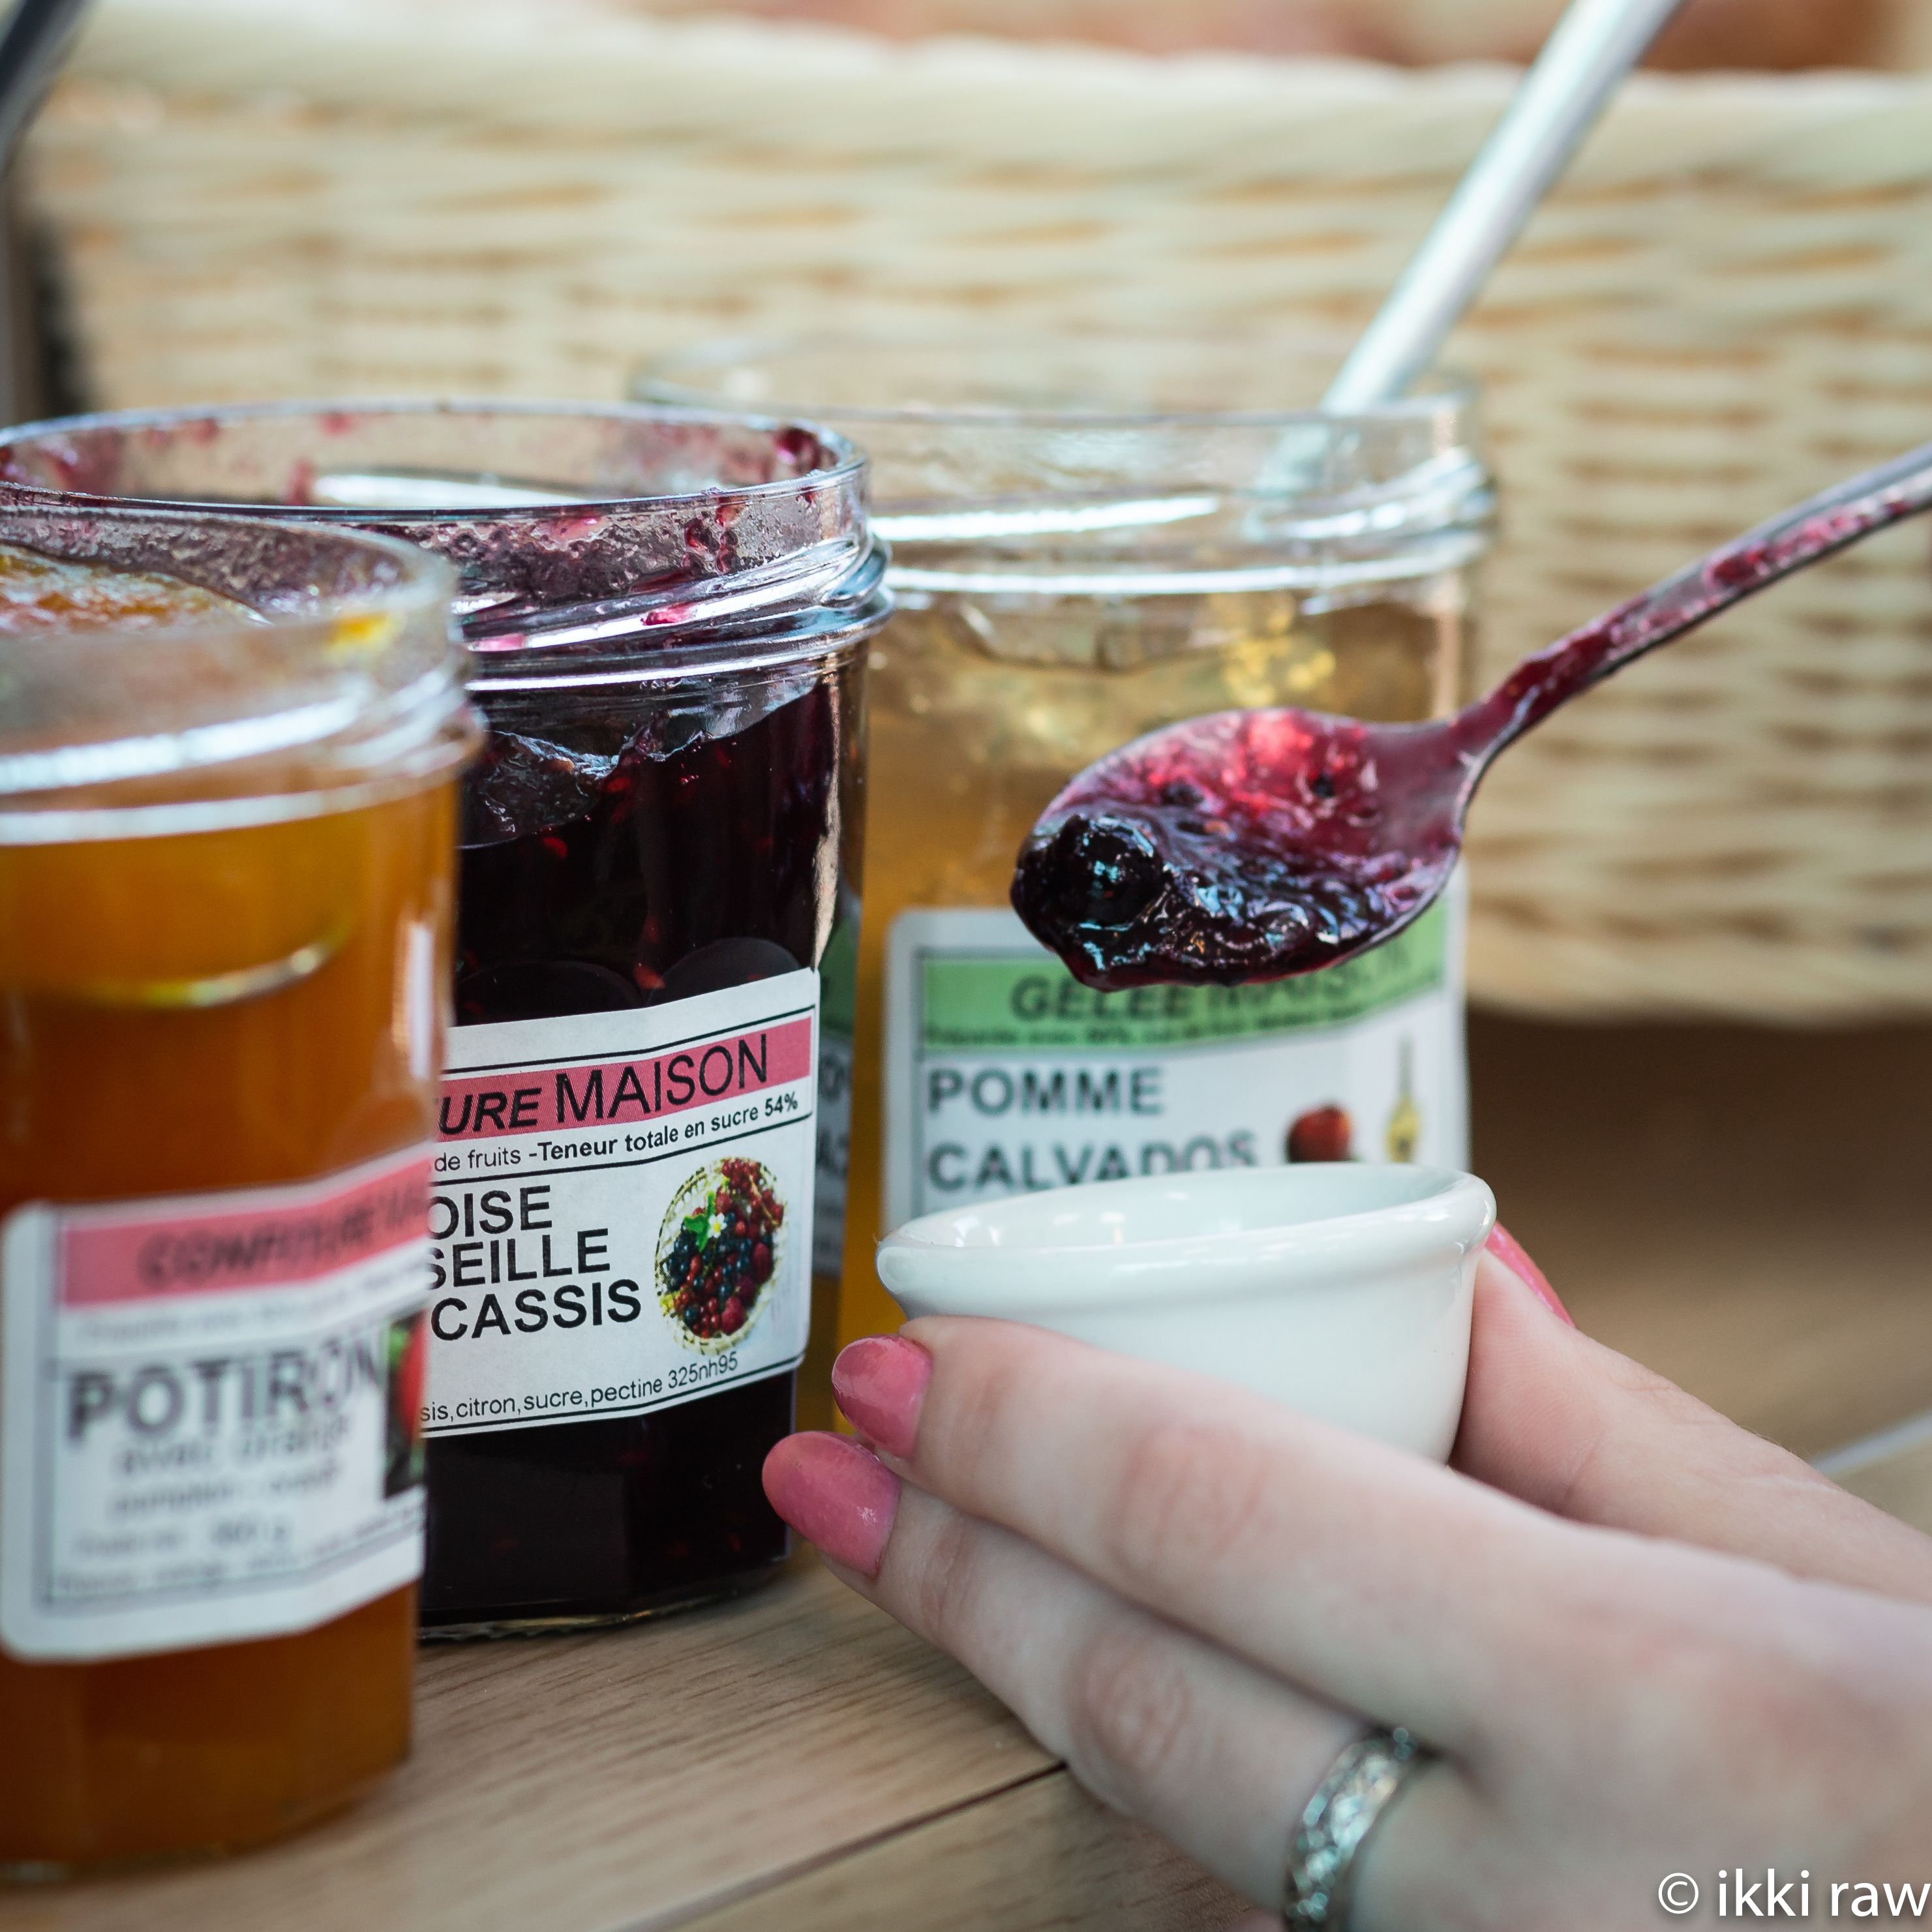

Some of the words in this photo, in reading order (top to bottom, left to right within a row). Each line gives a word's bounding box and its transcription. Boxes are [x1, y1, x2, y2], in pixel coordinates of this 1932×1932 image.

[555, 1034, 767, 1123] MAISON
[928, 1066, 1165, 1116] POMME
[434, 1153, 460, 1171] de
[468, 1147, 521, 1168] fruits
[529, 1139, 618, 1161] -Teneur
[625, 1125, 678, 1152] totale
[684, 1120, 704, 1138] en
[711, 1107, 759, 1132] sucre
[764, 1091, 798, 1117] 54%
[928, 1128, 1258, 1192] CALVADOS
[430, 1278, 642, 1341] CASSIS
[67, 1331, 386, 1449] POTIRON
